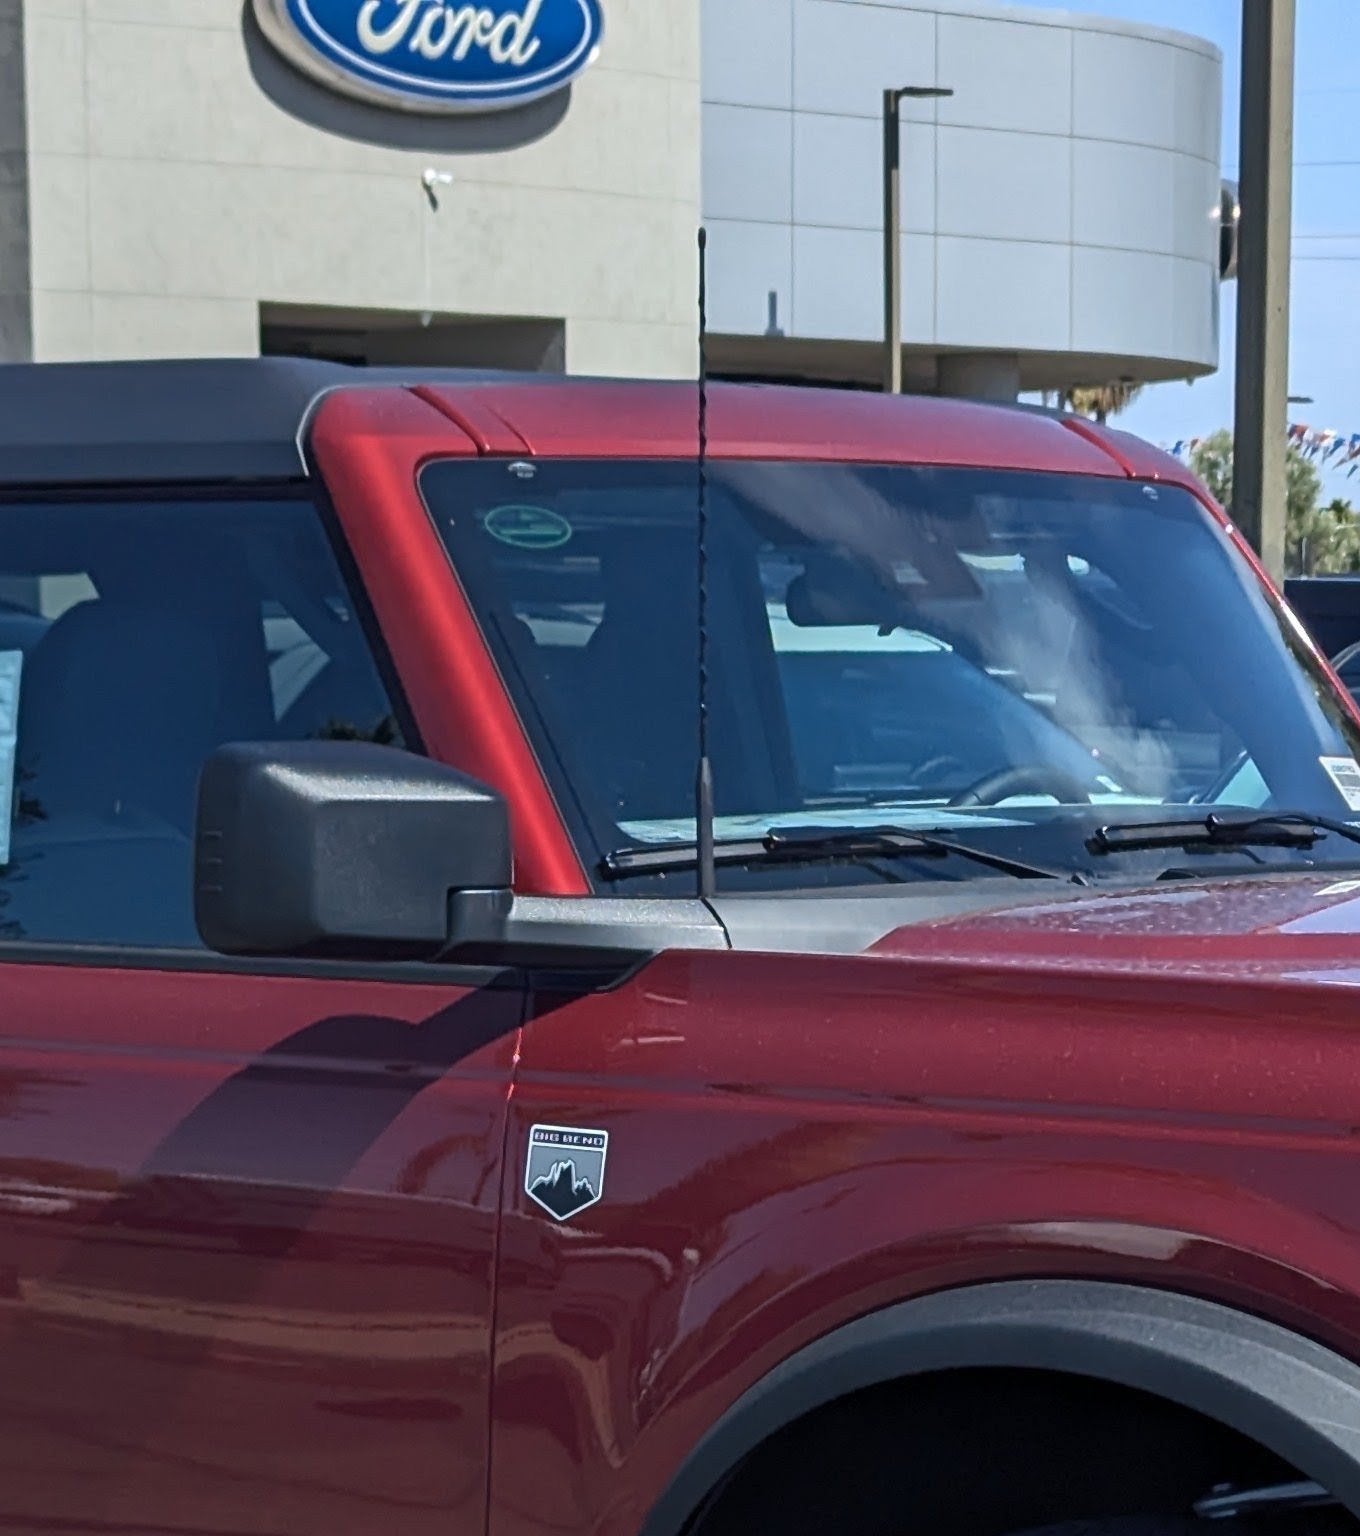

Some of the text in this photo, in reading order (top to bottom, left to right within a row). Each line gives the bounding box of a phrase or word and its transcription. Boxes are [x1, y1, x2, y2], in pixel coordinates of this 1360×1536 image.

[356, 0, 541, 66] Ford
[534, 1131, 603, 1145] BIG BEND
